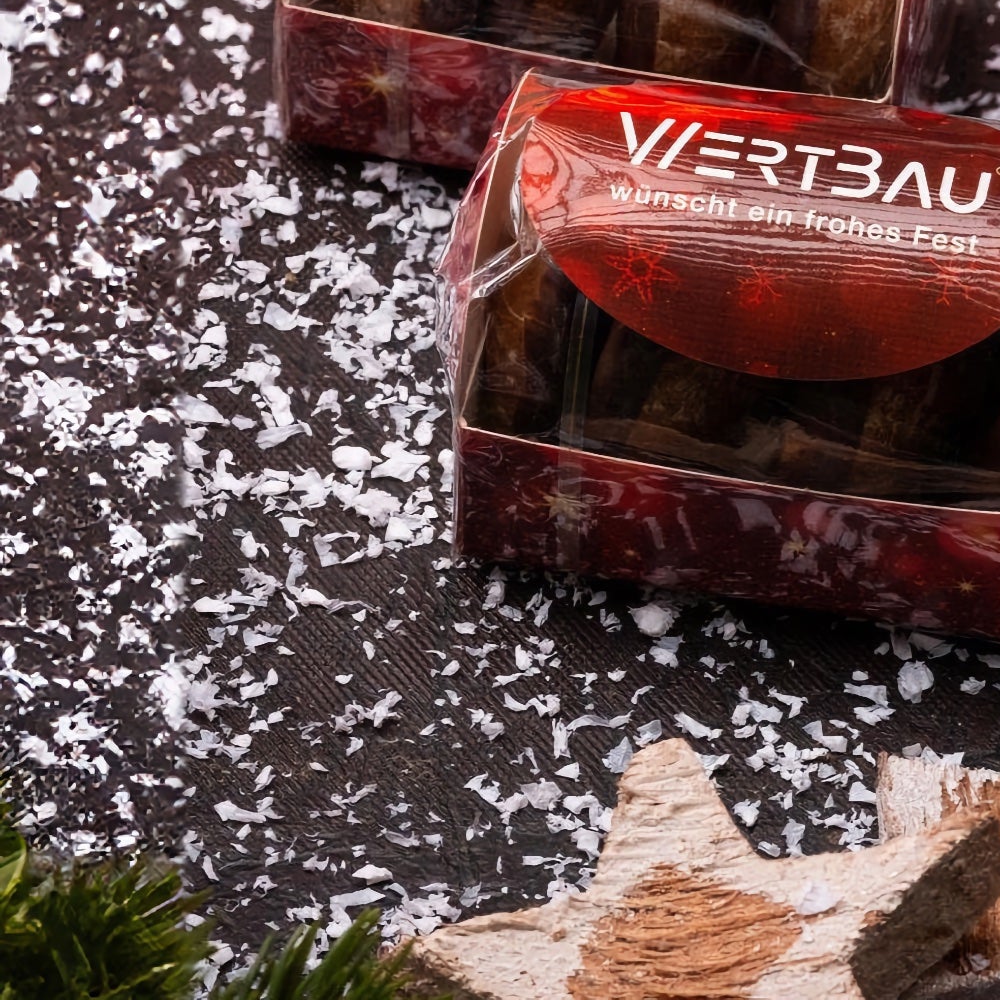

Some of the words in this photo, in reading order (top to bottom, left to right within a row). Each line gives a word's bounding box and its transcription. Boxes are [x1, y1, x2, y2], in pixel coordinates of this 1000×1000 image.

[610, 182, 738, 219] wünscht
[747, 204, 793, 228] ein
[804, 209, 902, 244] frohes
[912, 224, 979, 257] Fest
